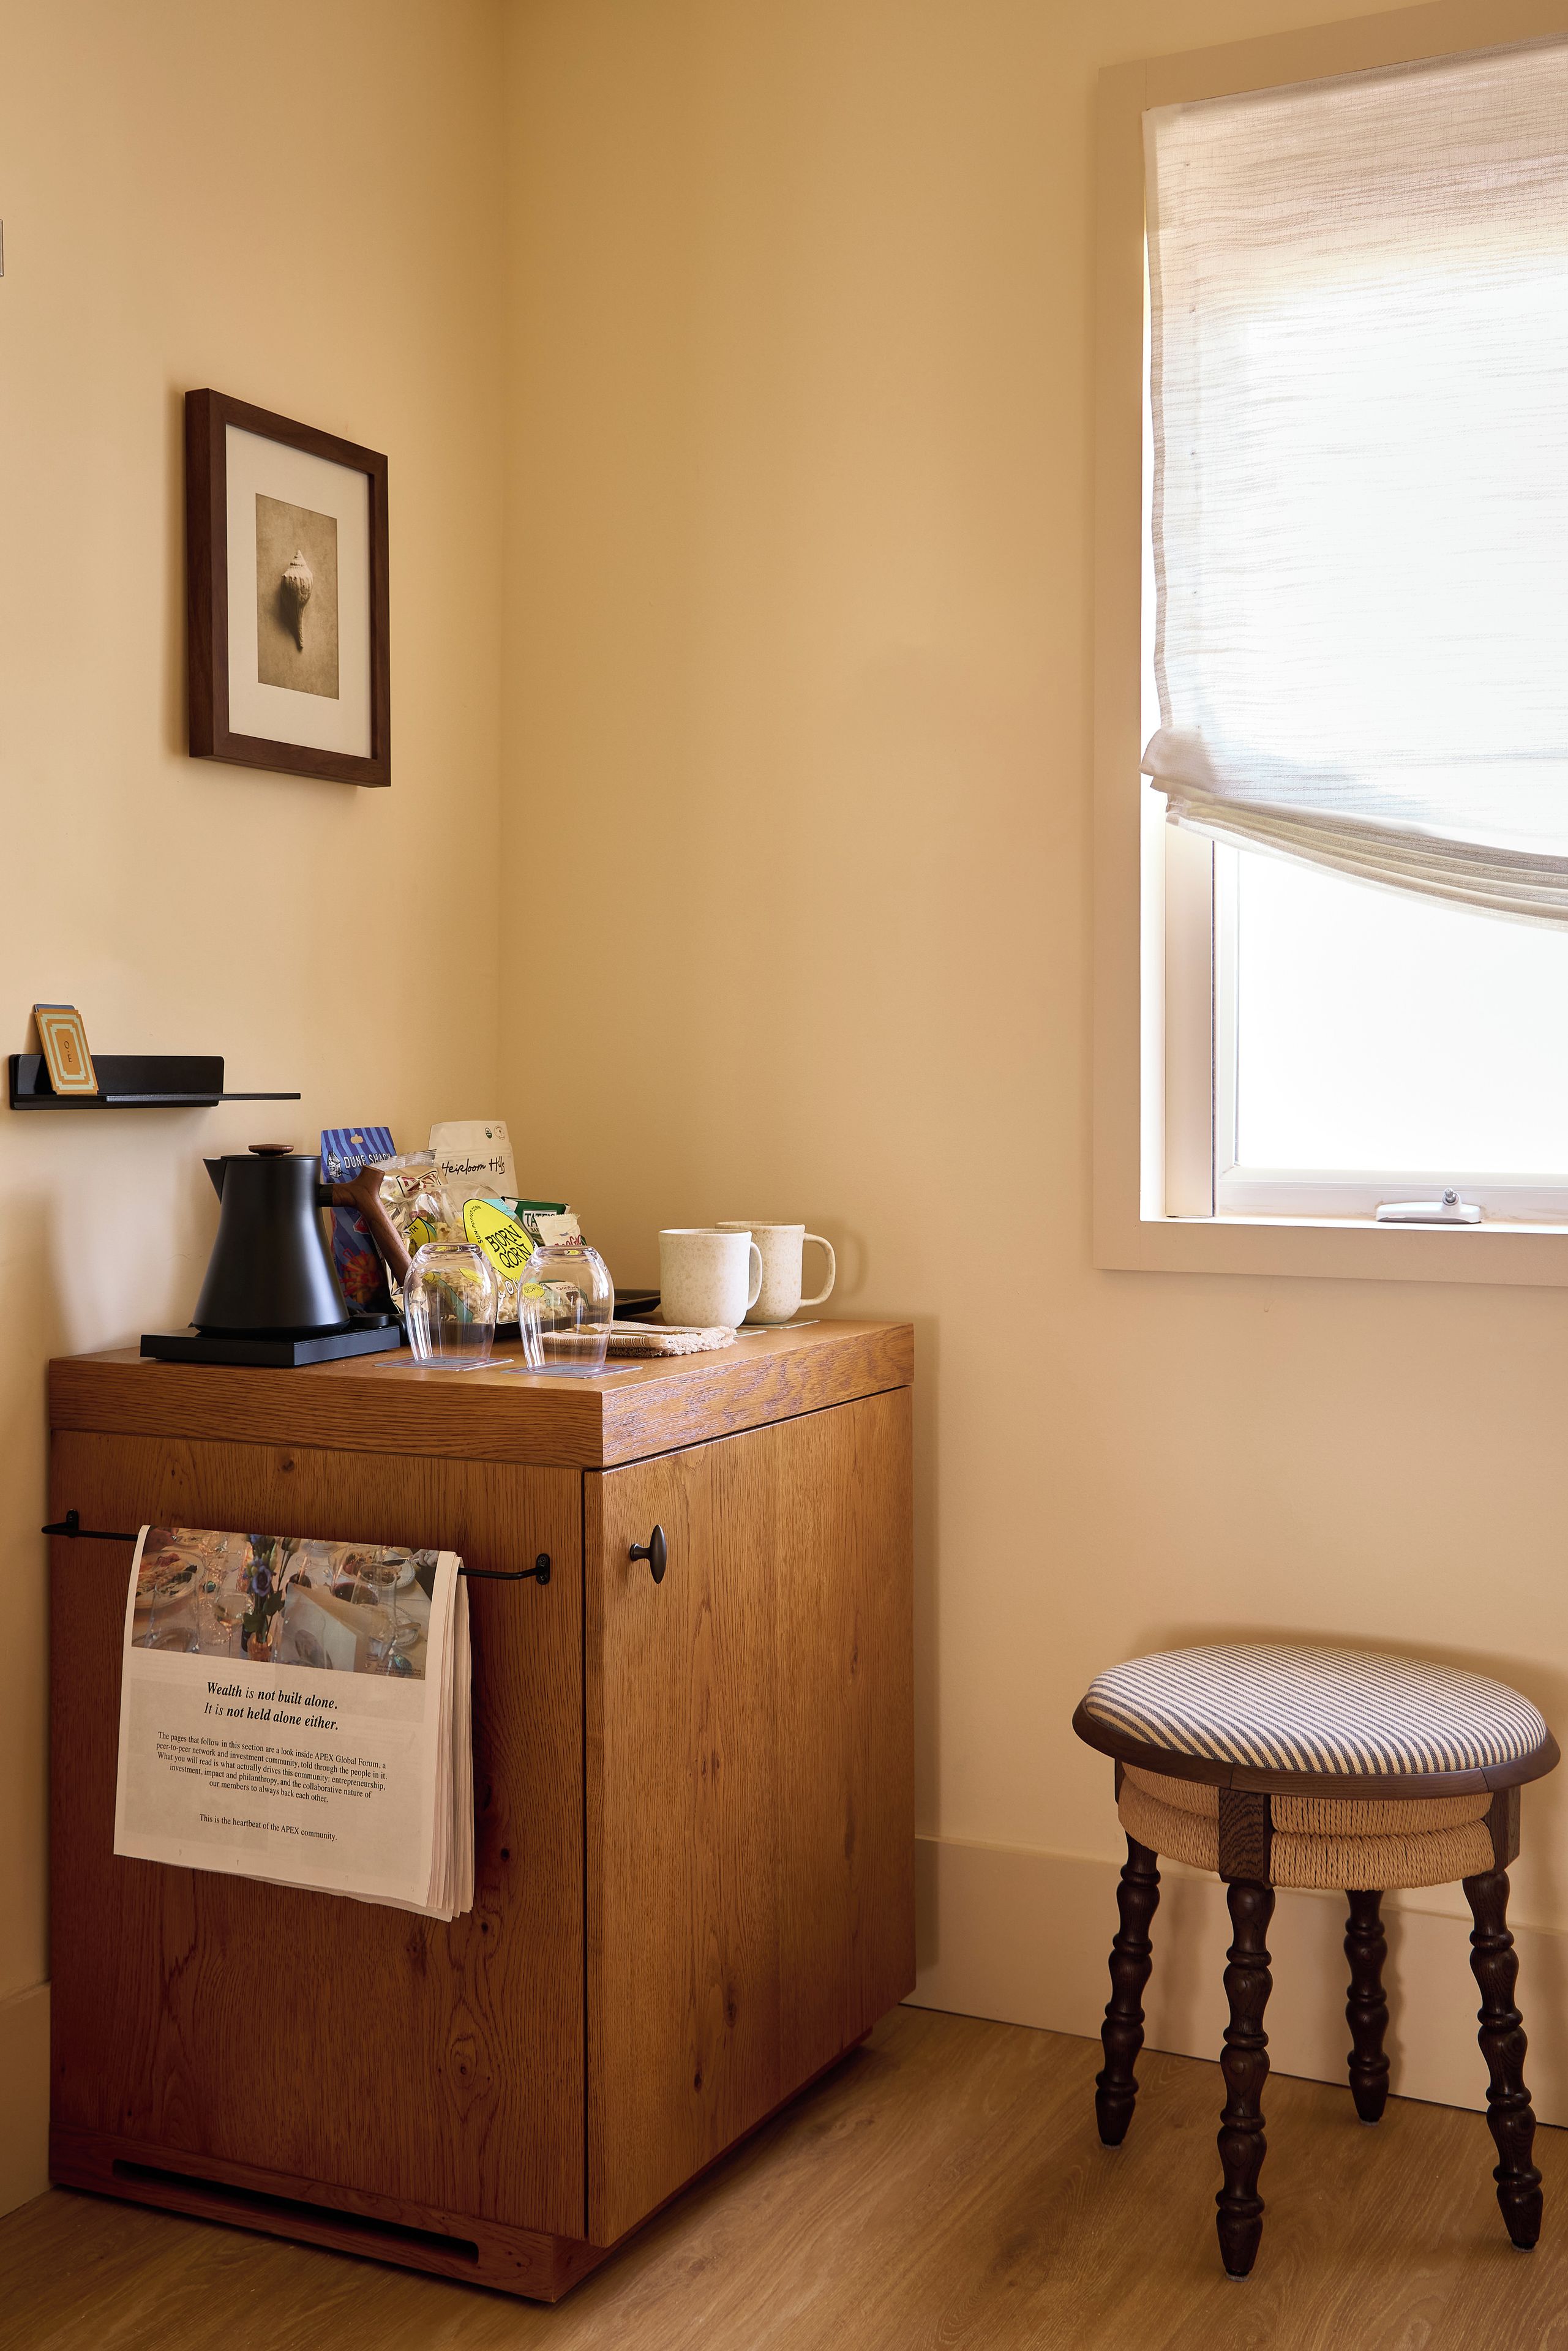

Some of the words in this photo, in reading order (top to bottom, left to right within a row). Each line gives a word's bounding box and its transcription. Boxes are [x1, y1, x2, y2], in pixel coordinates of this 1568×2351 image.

[343, 1155, 367, 1169] DUNE
[441, 1158, 486, 1177] Heirloom
[485, 1224, 522, 1254] BJORN
[499, 1243, 532, 1269] QORN
[207, 1682, 242, 1698] Wealth
[246, 1687, 255, 1700] is
[257, 1690, 276, 1701] not
[277, 1690, 303, 1705] built
[304, 1694, 338, 1710] alone.
[204, 1702, 213, 1715] It
[215, 1703, 224, 1716] is
[227, 1708, 245, 1719] not
[247, 1706, 272, 1722] held
[273, 1711, 302, 1726] alone
[304, 1715, 339, 1731] either.
[156, 1743, 192, 1754] peer-to-peer
[192, 1748, 216, 1757] network
[230, 1750, 264, 1763] investment
[265, 1757, 300, 1769] community,
[301, 1761, 313, 1769] told
[314, 1763, 338, 1774] through
[339, 1766, 349, 1775] the
[351, 1769, 372, 1779] people
[373, 1770, 379, 1779] in
[158, 1731, 170, 1740] The
[171, 1735, 187, 1744] pages
[189, 1736, 200, 1744] that
[201, 1737, 220, 1747] follow
[222, 1739, 228, 1748] in
[229, 1741, 241, 1750] this
[242, 1743, 264, 1752] section
[281, 1747, 294, 1757] look
[295, 1749, 313, 1760] inside
[314, 1752, 334, 1762] APEX
[336, 1755, 356, 1766] Global
[358, 1758, 381, 1770] Forum,
[158, 1751, 173, 1761] What
[187, 1756, 198, 1764] will
[214, 1759, 219, 1768] is
[220, 1760, 235, 1769] what
[237, 1763, 262, 1774] actually
[263, 1765, 281, 1775] drives
[282, 1768, 293, 1777] this
[294, 1771, 330, 1783] community:
[332, 1777, 386, 1791] entrepreneurship,
[170, 1763, 203, 1776] investment,
[204, 1768, 225, 1779] impact
[239, 1772, 279, 1787] philanthropy,
[280, 1779, 291, 1787] and
[292, 1780, 302, 1788] the
[302, 1782, 342, 1794] collaborative
[343, 1789, 363, 1798] nature
[221, 1782, 250, 1791] members
[259, 1785, 280, 1797] always
[281, 1788, 294, 1798] back
[311, 1793, 329, 1803] other.
[199, 1813, 213, 1823] This
[214, 1815, 220, 1824] is
[222, 1817, 231, 1825] the
[233, 1818, 261, 1829] heartbeat
[271, 1823, 280, 1832] the
[280, 1825, 299, 1835] APEX
[301, 1830, 337, 1842] community.
